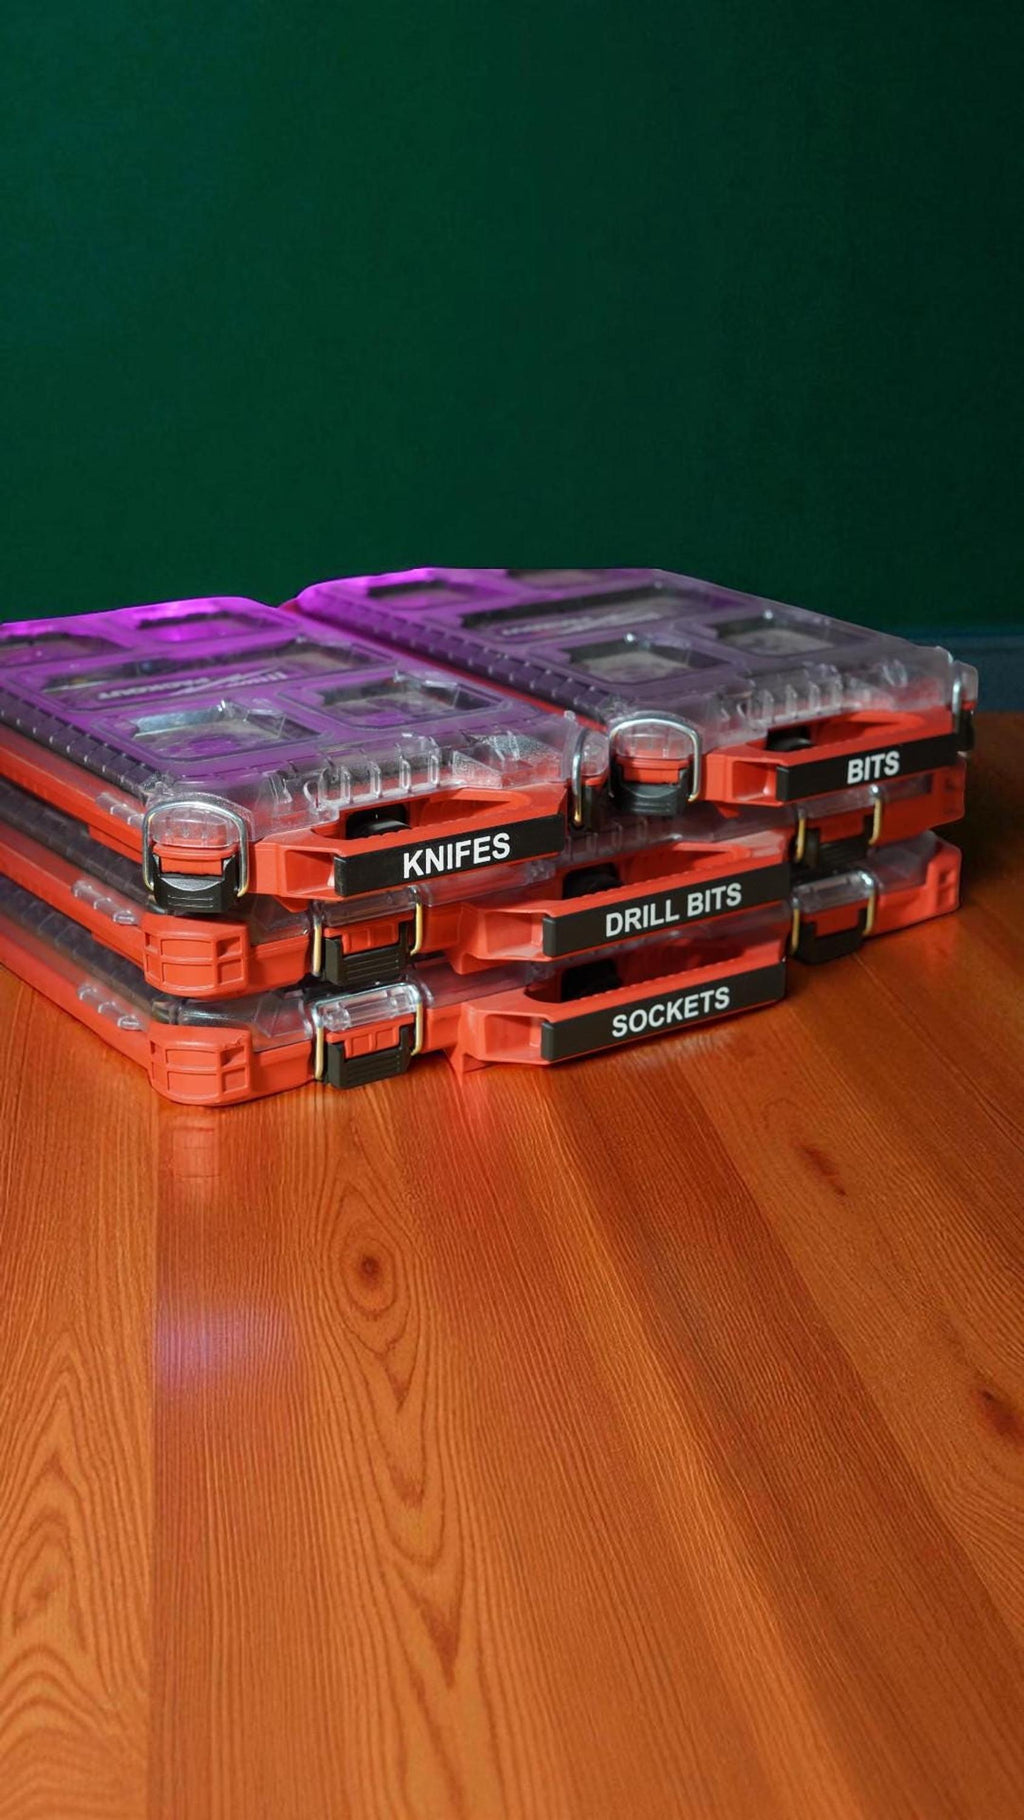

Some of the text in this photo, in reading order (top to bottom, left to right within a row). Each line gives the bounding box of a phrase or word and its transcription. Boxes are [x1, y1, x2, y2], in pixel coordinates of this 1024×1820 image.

[847, 751, 900, 784] BITS
[402, 832, 511, 879] KNIFES
[605, 882, 742, 937] DRILL BITS
[611, 986, 730, 1038] SOCKETS
